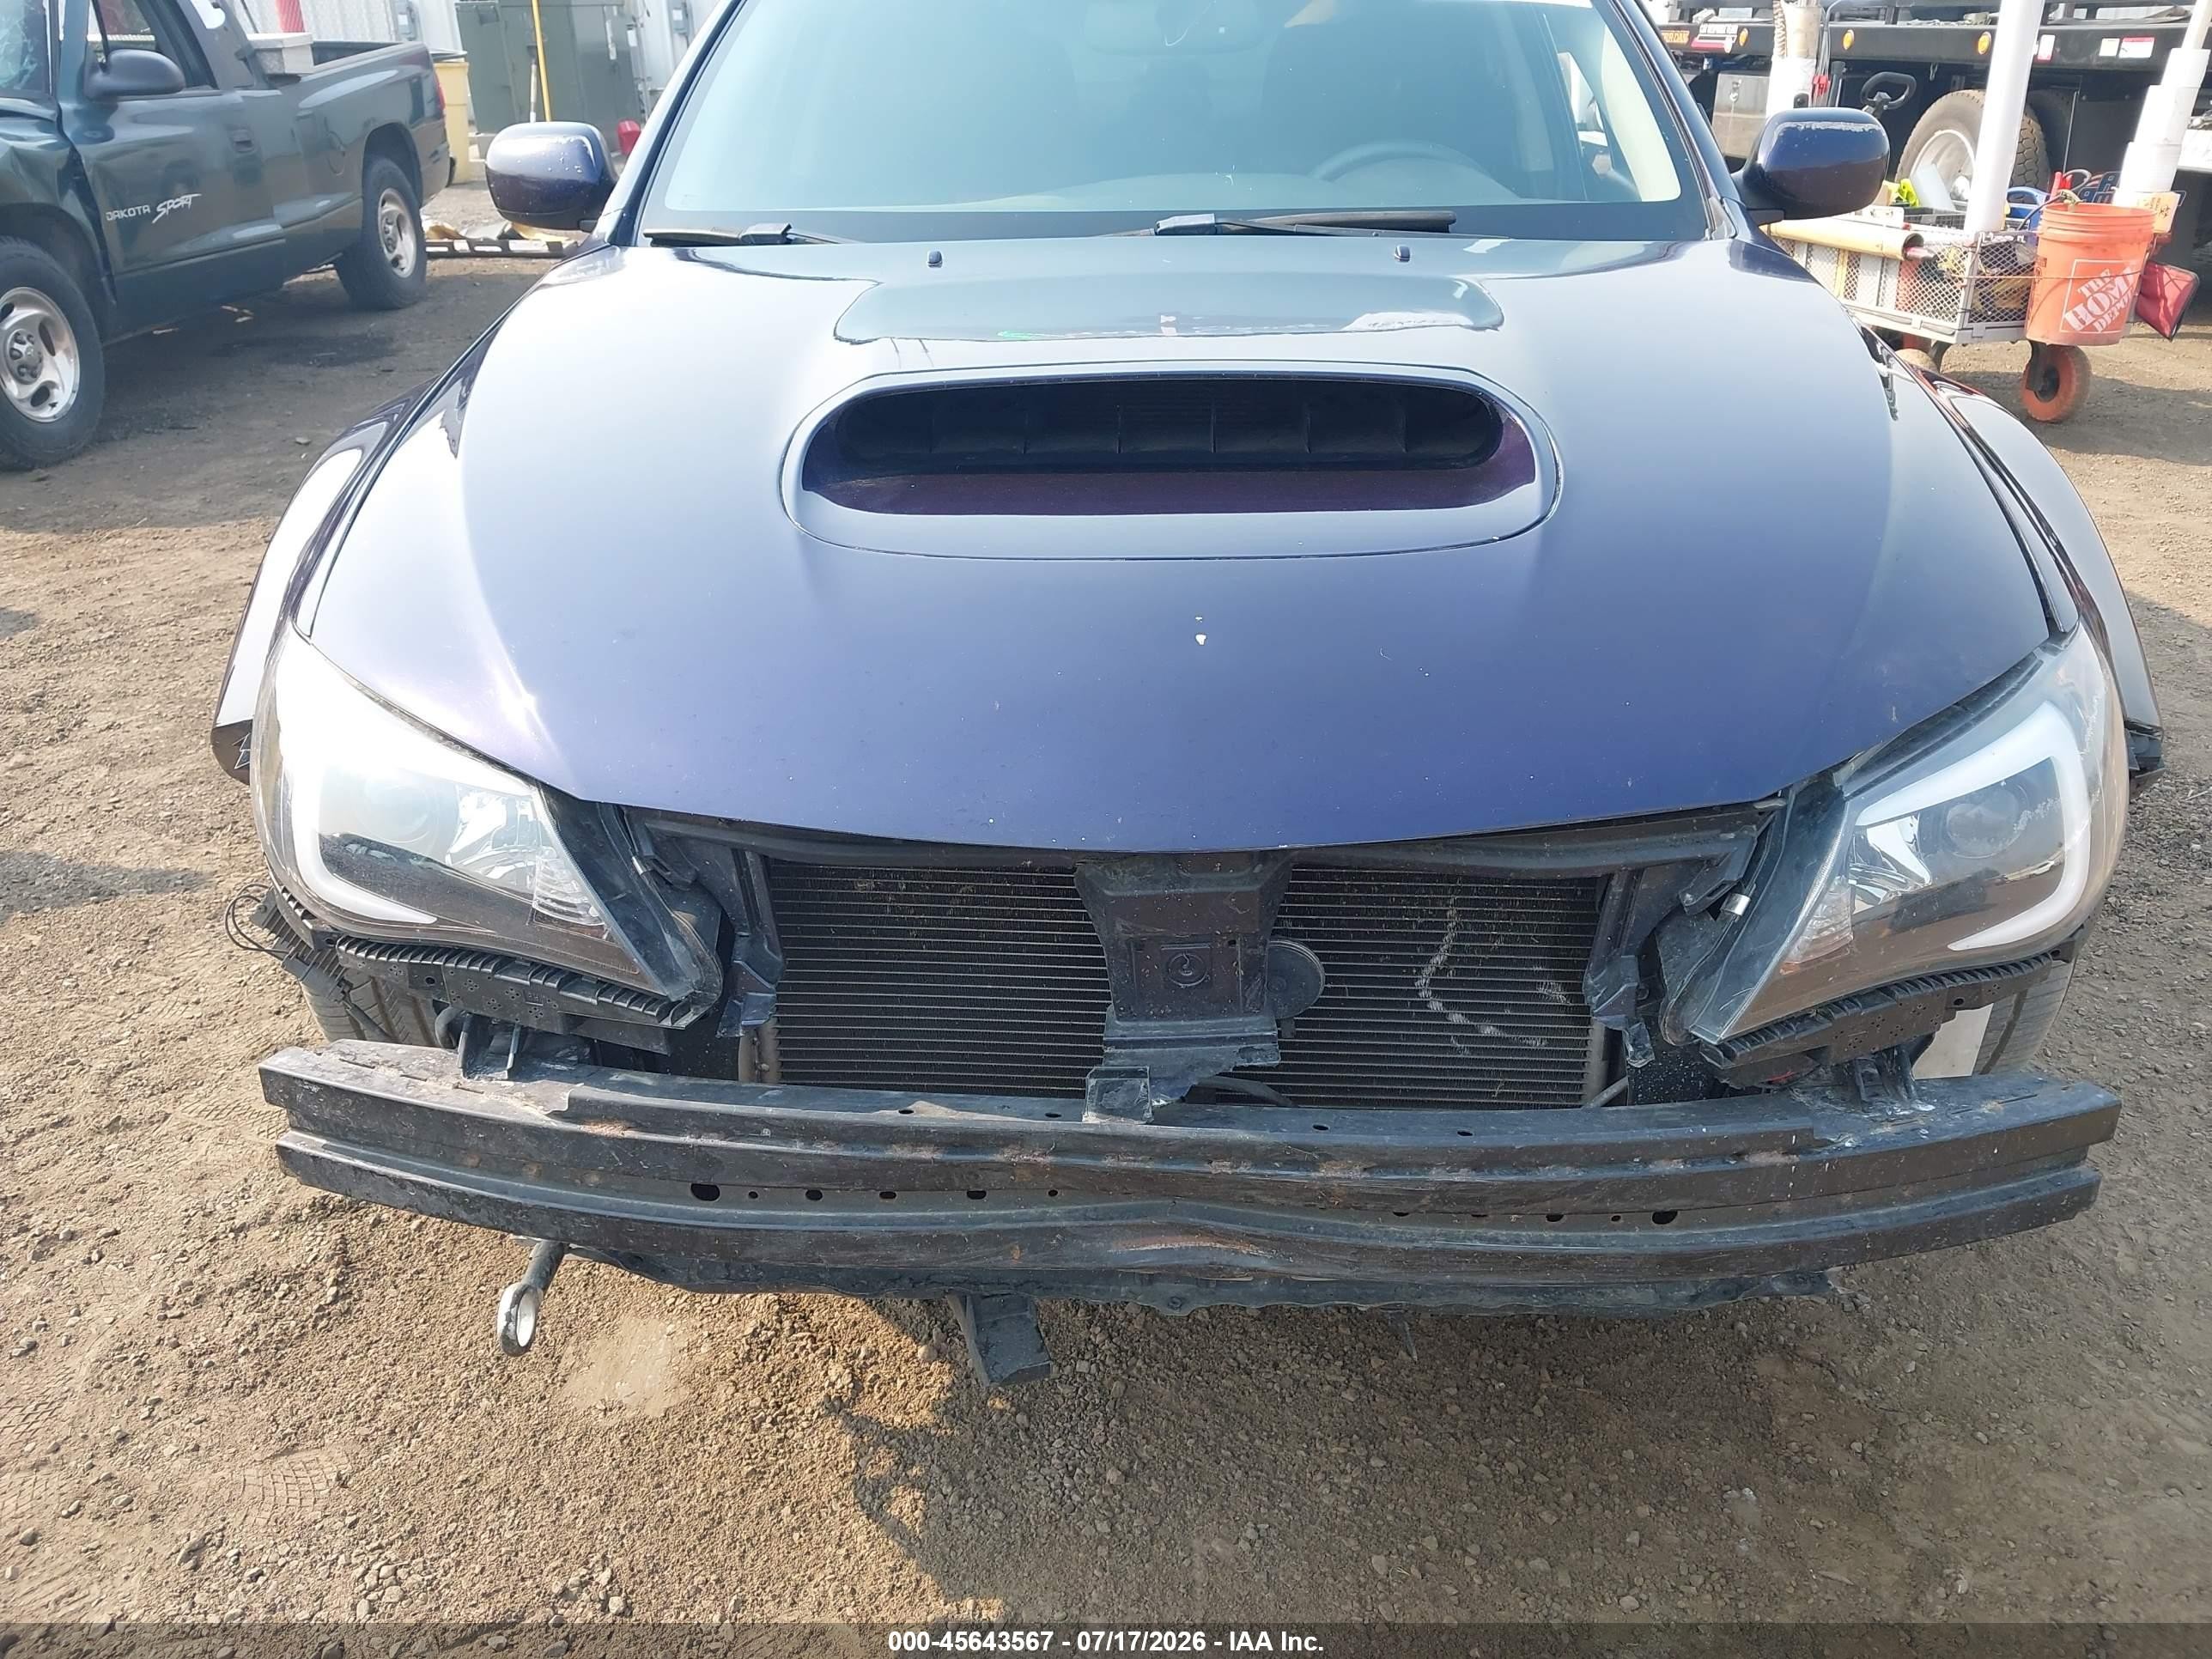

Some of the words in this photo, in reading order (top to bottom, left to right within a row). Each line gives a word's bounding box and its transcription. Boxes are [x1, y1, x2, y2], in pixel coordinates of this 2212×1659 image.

[106, 204, 151, 222] DAKOTA
[151, 192, 203, 224] SPORT
[2077, 268, 2111, 298] THE
